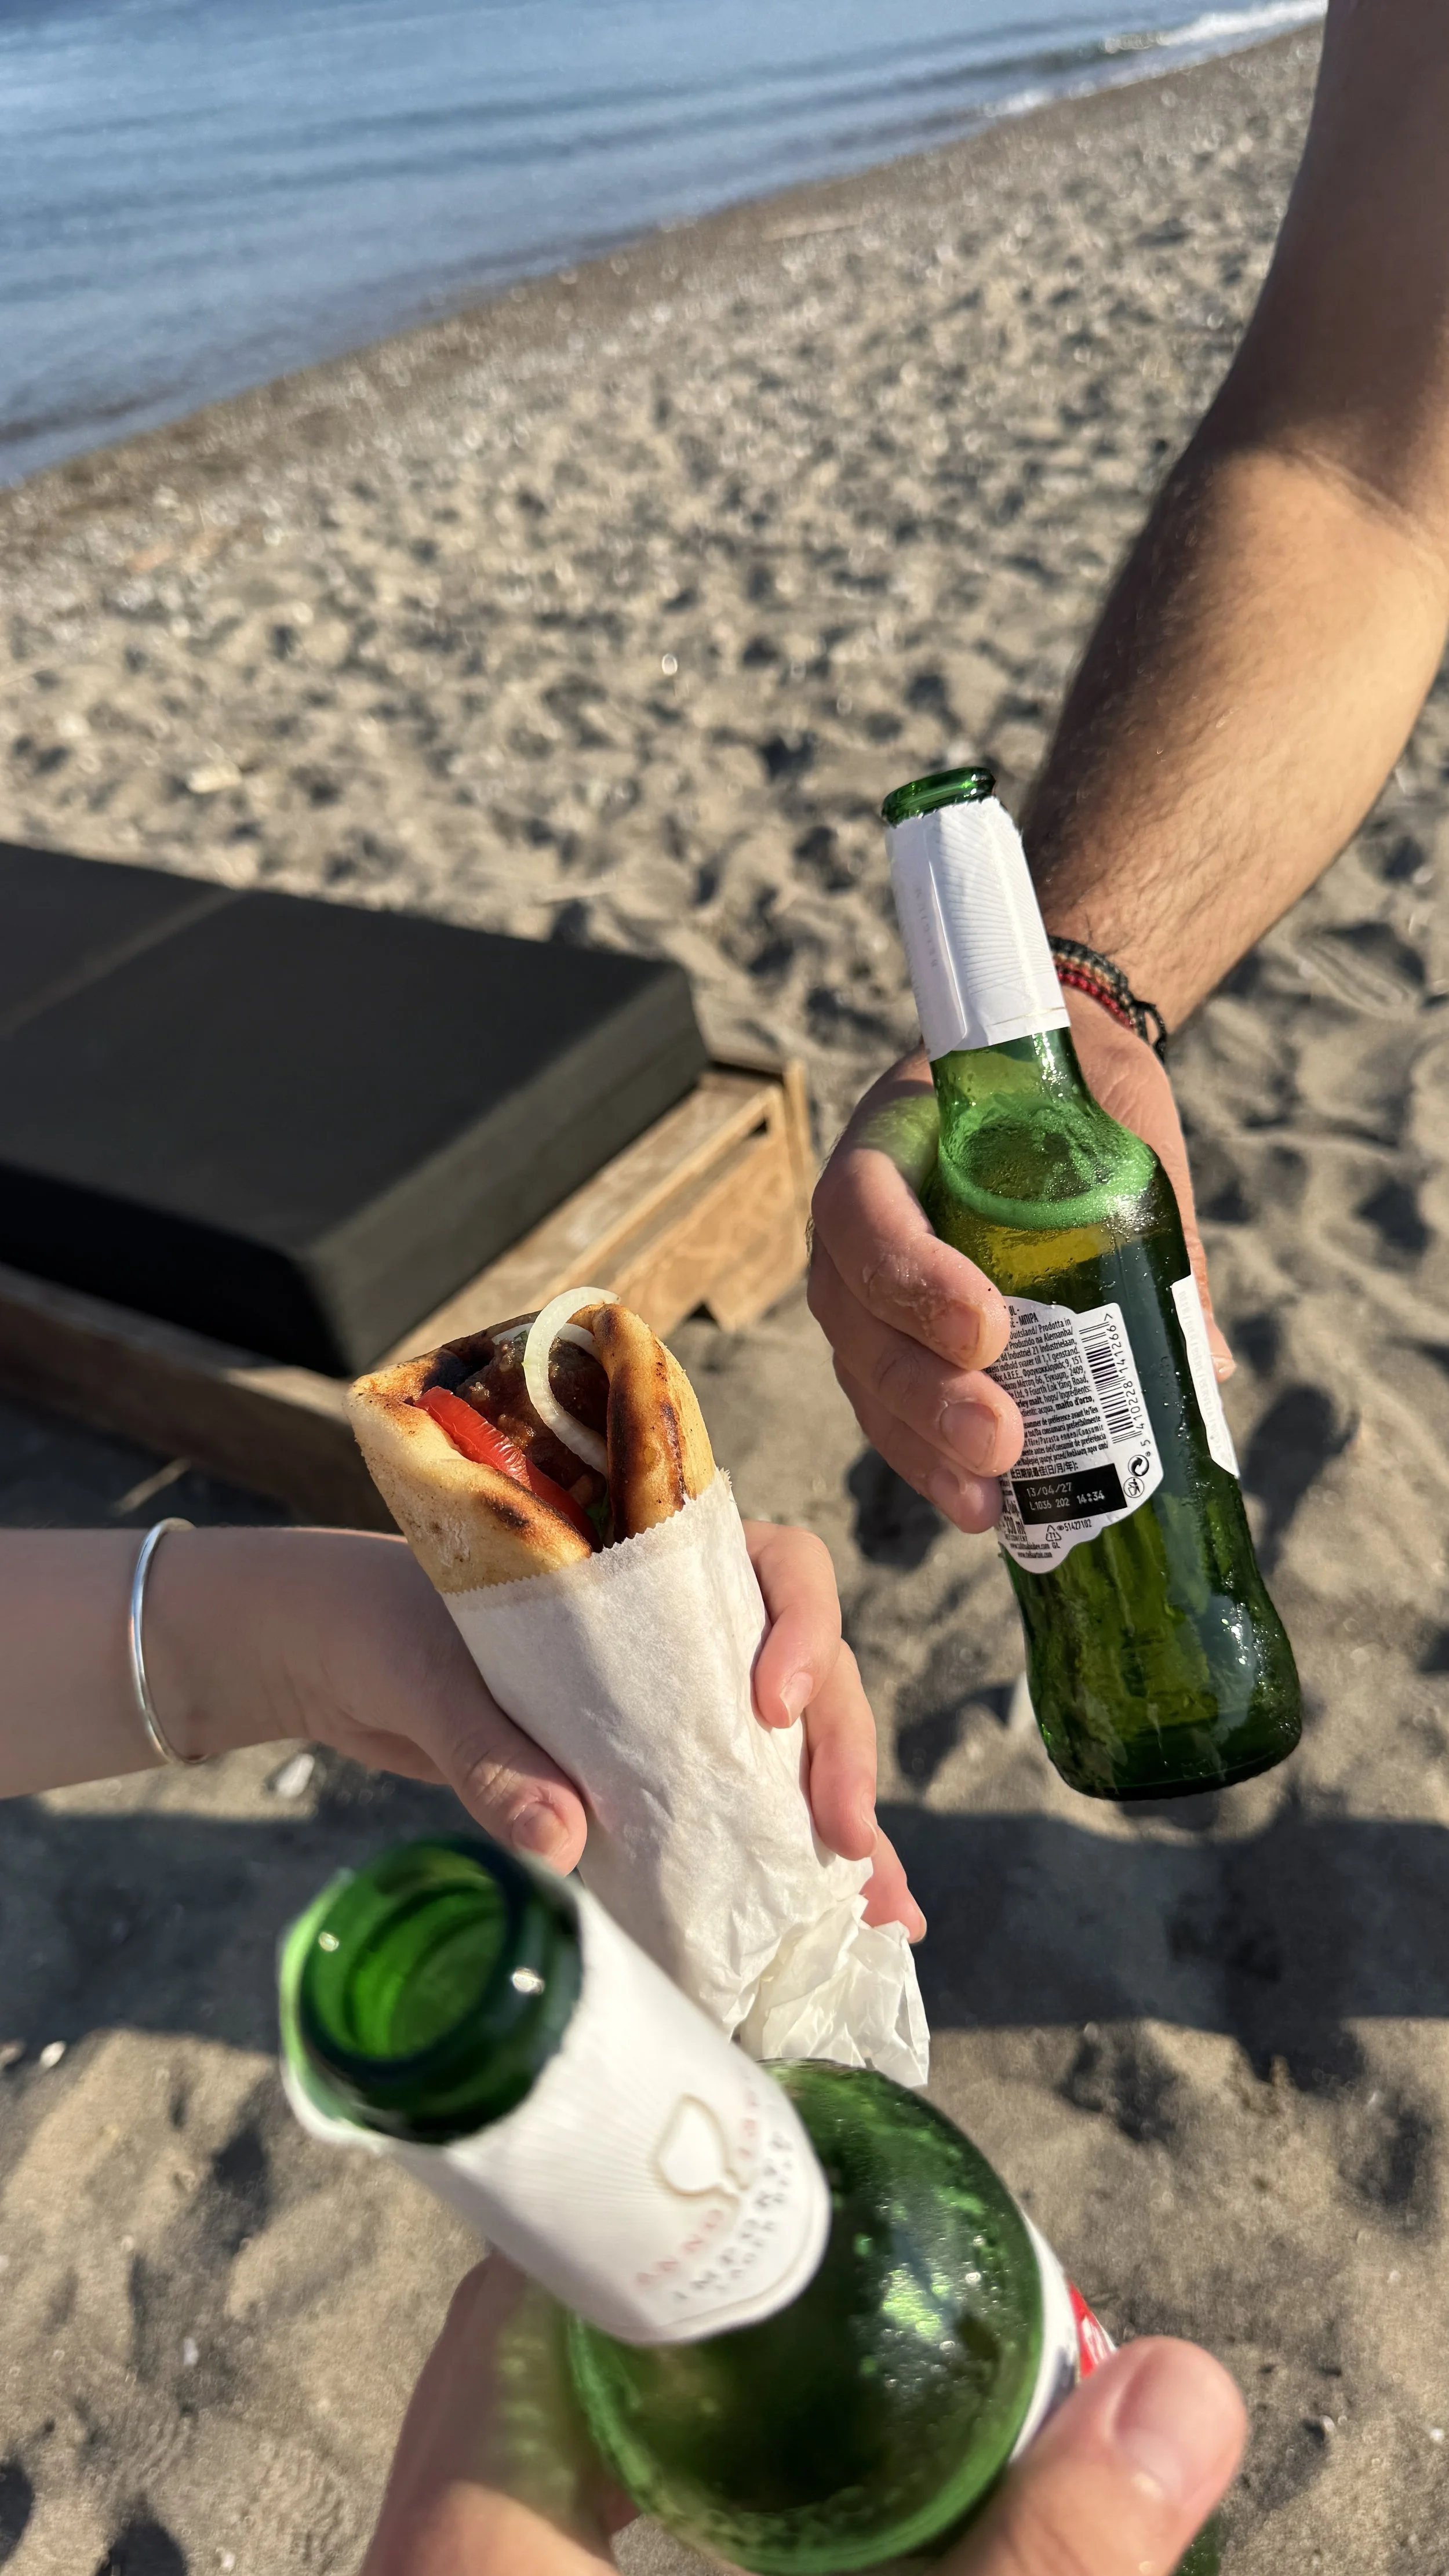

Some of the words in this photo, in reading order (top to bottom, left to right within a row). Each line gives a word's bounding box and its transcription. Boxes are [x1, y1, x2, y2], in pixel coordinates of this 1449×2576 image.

[1038, 1321, 1064, 1333] Prodotta
[1009, 1338, 1035, 1349] Produzido
[1043, 1326, 1073, 1342] Alemanha/
[1007, 1347, 1032, 1360] Industriel
[1032, 1346, 1039, 1355] 21
[1039, 1338, 1077, 1353] Industrielaan,
[1106, 1325, 1128, 1373] 141266
[999, 1360, 1018, 1371] indhold
[1018, 1359, 1034, 1368] svarer
[1042, 1354, 1051, 1363] 1,1
[1051, 1346, 1080, 1362] genstand.
[1065, 1359, 1072, 1368] 9,
[1072, 1355, 1082, 1365] 151
[1035, 1376, 1044, 1385] 66,
[1069, 1365, 1086, 1377] 2409,
[1014, 1389, 1024, 1398] Ltd,
[1024, 1388, 1028, 1396] 9
[1029, 1384, 1047, 1396] Fourth
[1047, 1382, 1057, 1392] Lok
[1057, 1380, 1072, 1389] Yang
[1071, 1374, 1088, 1385] Road,
[1015, 1399, 1028, 1409] rley
[1029, 1396, 1044, 1406] malt,
[1043, 1392, 1058, 1403] hops/
[1059, 1385, 1091, 1400] Ingredients:
[1123, 1381, 1145, 1429] 410228
[1037, 1405, 1055, 1415] acqua,
[1055, 1400, 1073, 1410] malto
[1042, 1417, 1047, 1425] de
[1071, 1410, 1084, 1419] avant
[1066, 1416, 1101, 1431] preferibilmente
[1026, 1482, 1072, 1497] 13/04/27
[1055, 1498, 1070, 1507] 202
[1076, 1490, 1105, 1504] 14:34
[1064, 1519, 1092, 1531] 51427102
